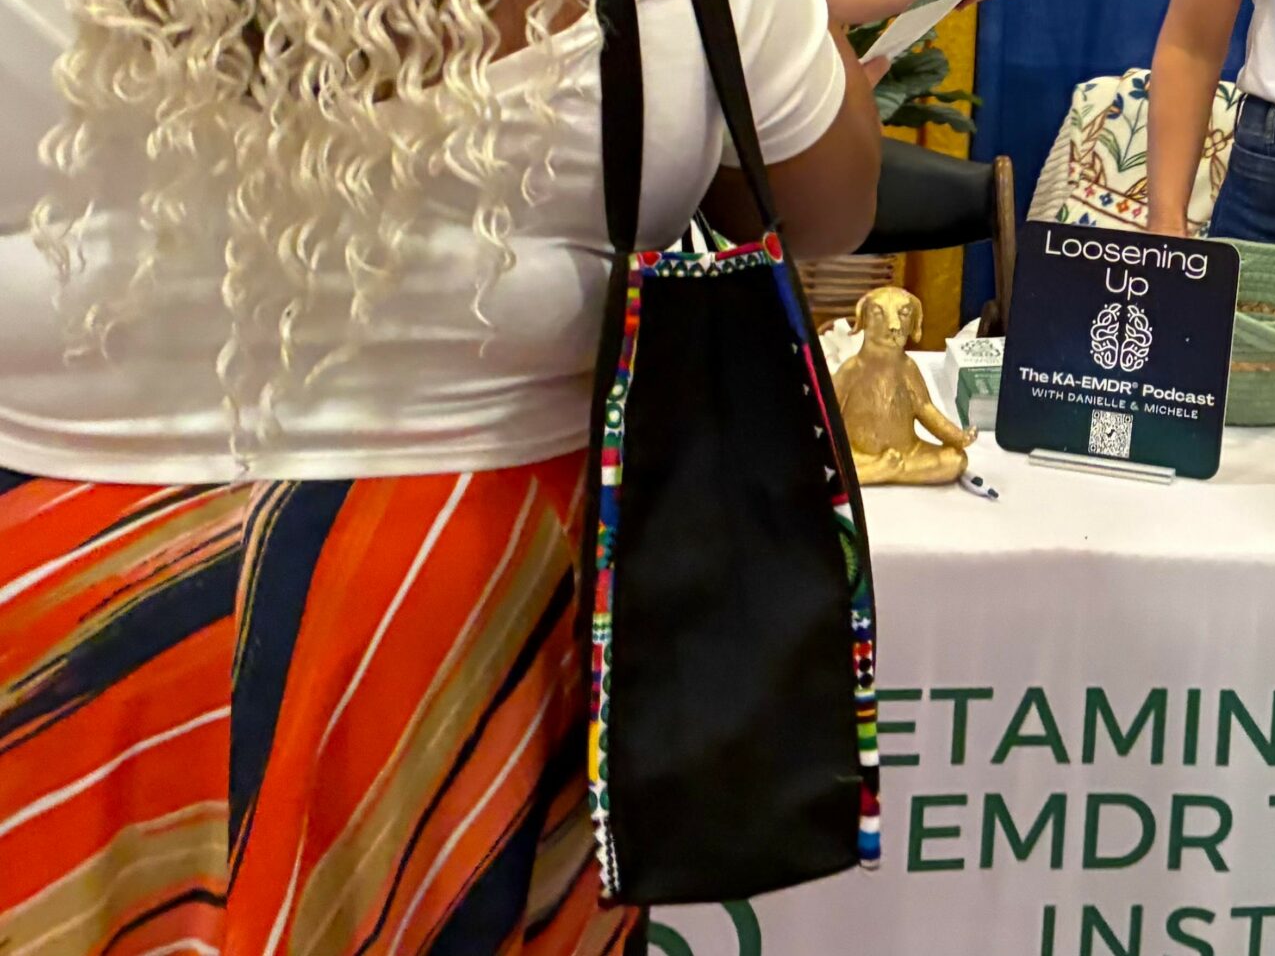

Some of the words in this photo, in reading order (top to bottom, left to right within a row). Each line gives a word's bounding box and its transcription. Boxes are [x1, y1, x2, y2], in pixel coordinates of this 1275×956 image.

[1045, 230, 1208, 279] Loosening
[1105, 267, 1149, 300] Up
[1019, 367, 1049, 383] The
[1143, 384, 1215, 406] Podcast
[1031, 387, 1063, 401] WITH
[1068, 393, 1126, 409] DANIELLE
[1130, 401, 1139, 411] &
[1144, 404, 1198, 419] MICHELE
[907, 793, 1233, 872] EMDR
